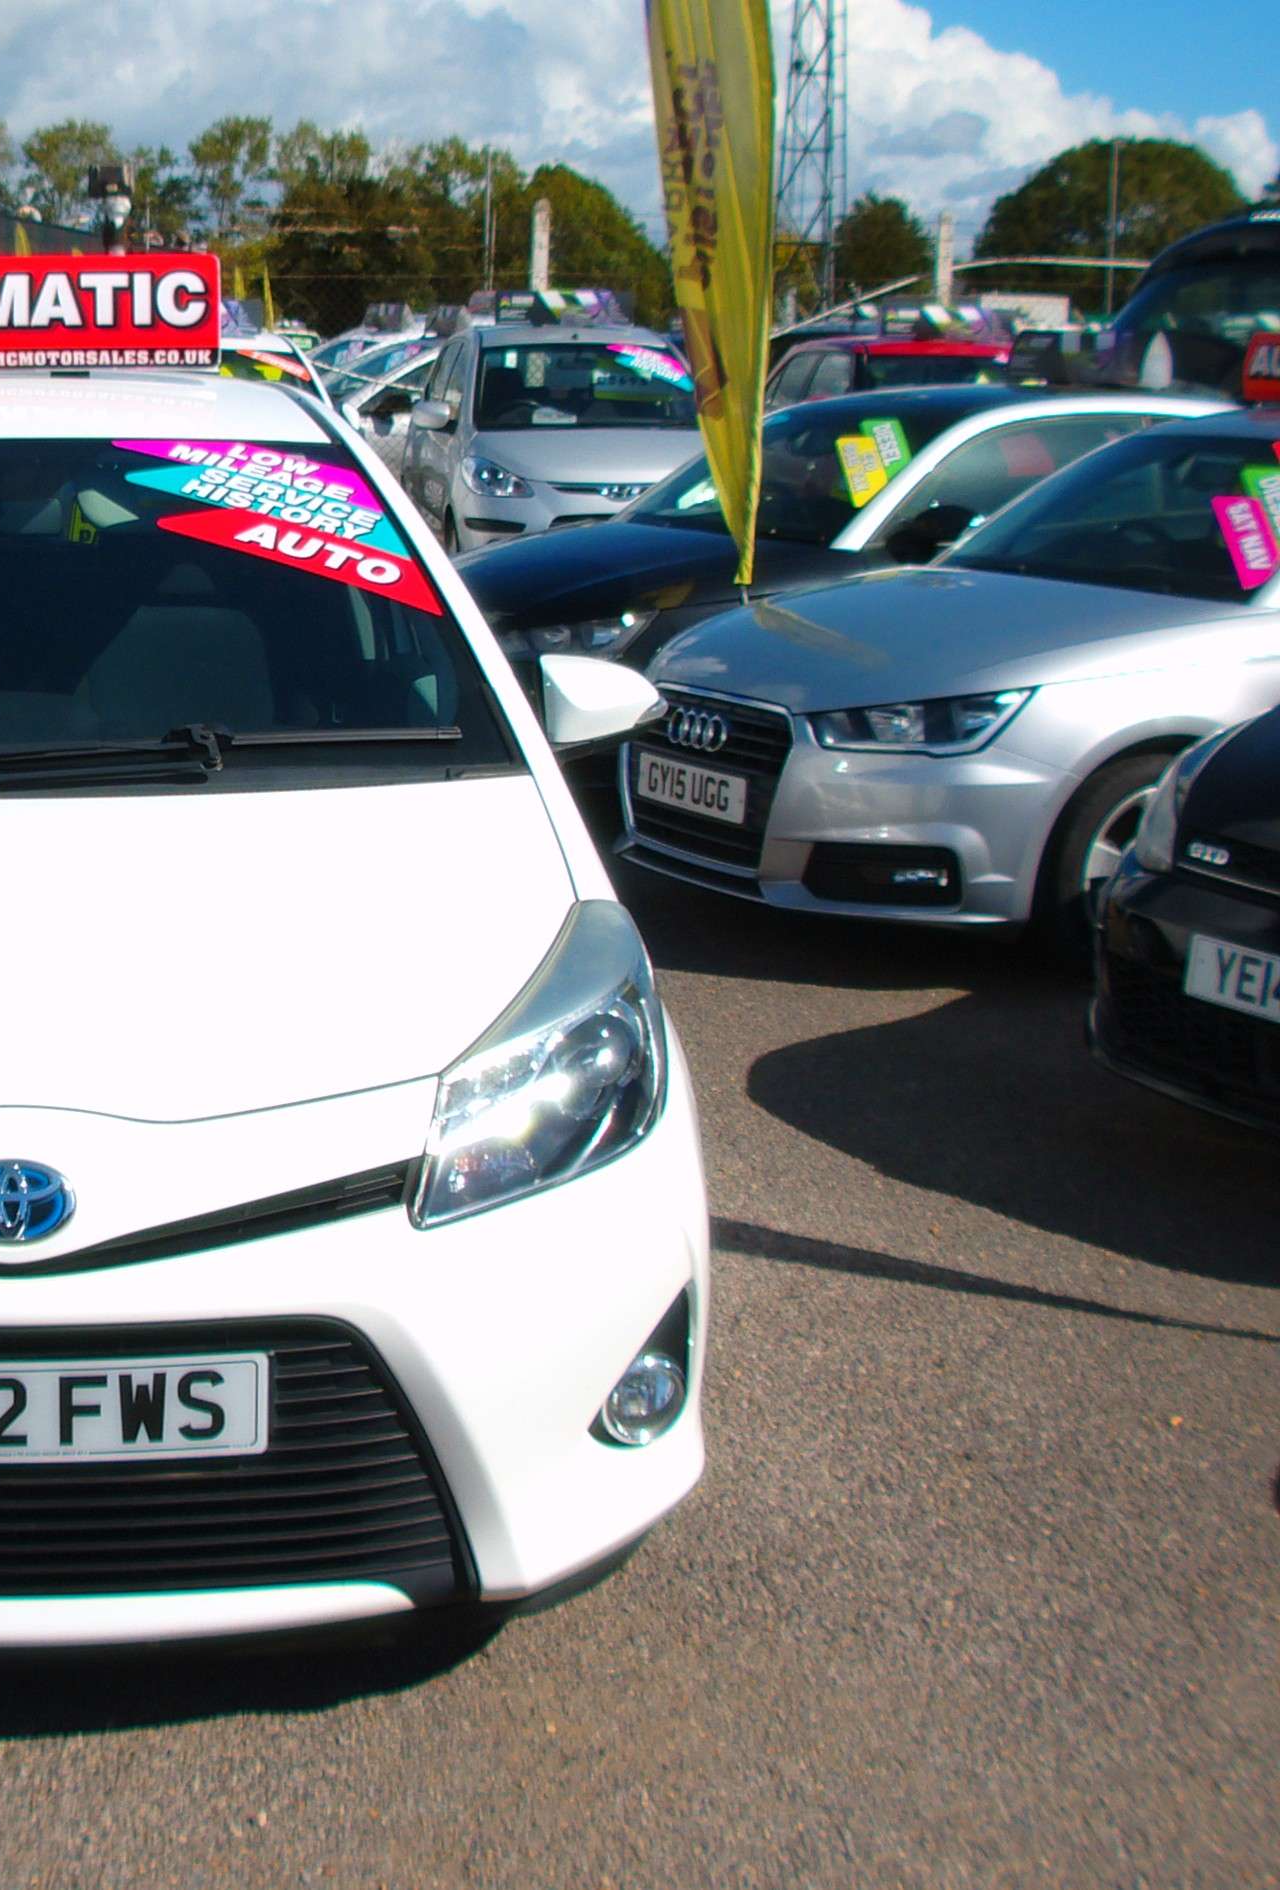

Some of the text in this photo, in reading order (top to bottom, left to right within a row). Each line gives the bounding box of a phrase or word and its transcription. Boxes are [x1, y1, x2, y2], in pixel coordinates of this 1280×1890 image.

[168, 444, 356, 501] MILEAGE
[226, 444, 320, 477] LOW
[180, 478, 372, 540] HISTORY
[199, 467, 383, 528] SERVICE
[233, 523, 402, 584] AUTO
[1239, 533, 1272, 570] NAV
[648, 761, 730, 812] GY15 UGG
[58, 1370, 227, 1447] FWS
